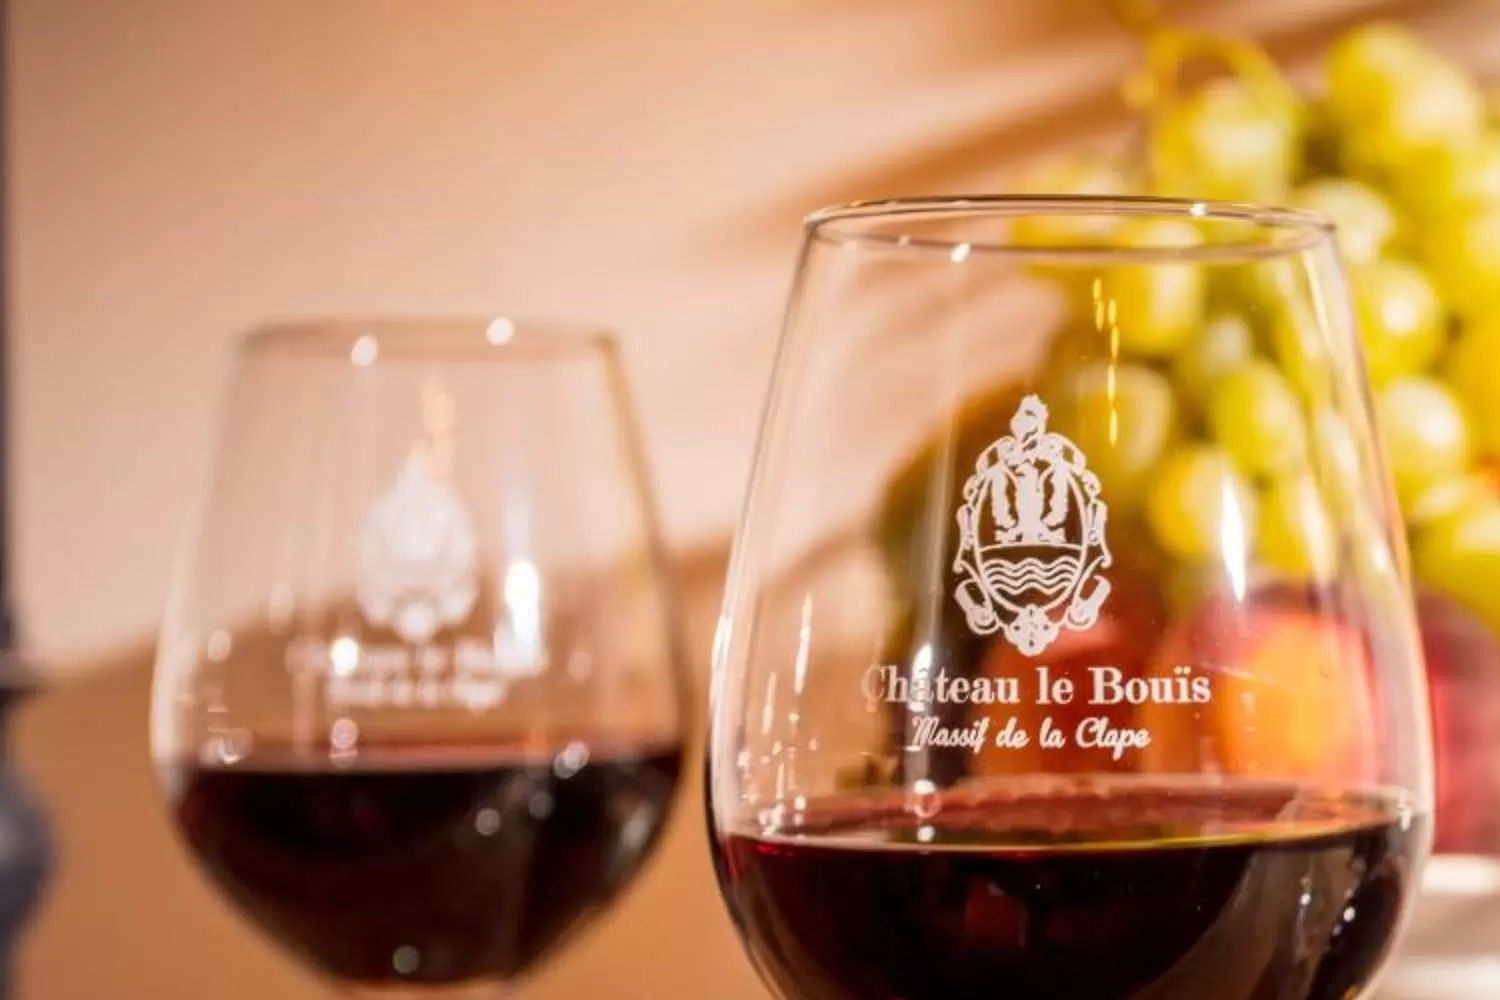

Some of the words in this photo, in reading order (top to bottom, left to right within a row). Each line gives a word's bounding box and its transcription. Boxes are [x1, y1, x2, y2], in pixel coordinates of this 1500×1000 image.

[1035, 665, 1075, 705] le
[1087, 665, 1212, 705] Bouïs
[911, 715, 991, 755] Massif
[995, 716, 1030, 749] de
[1039, 715, 1067, 749] la
[1075, 716, 1152, 761] Clape
